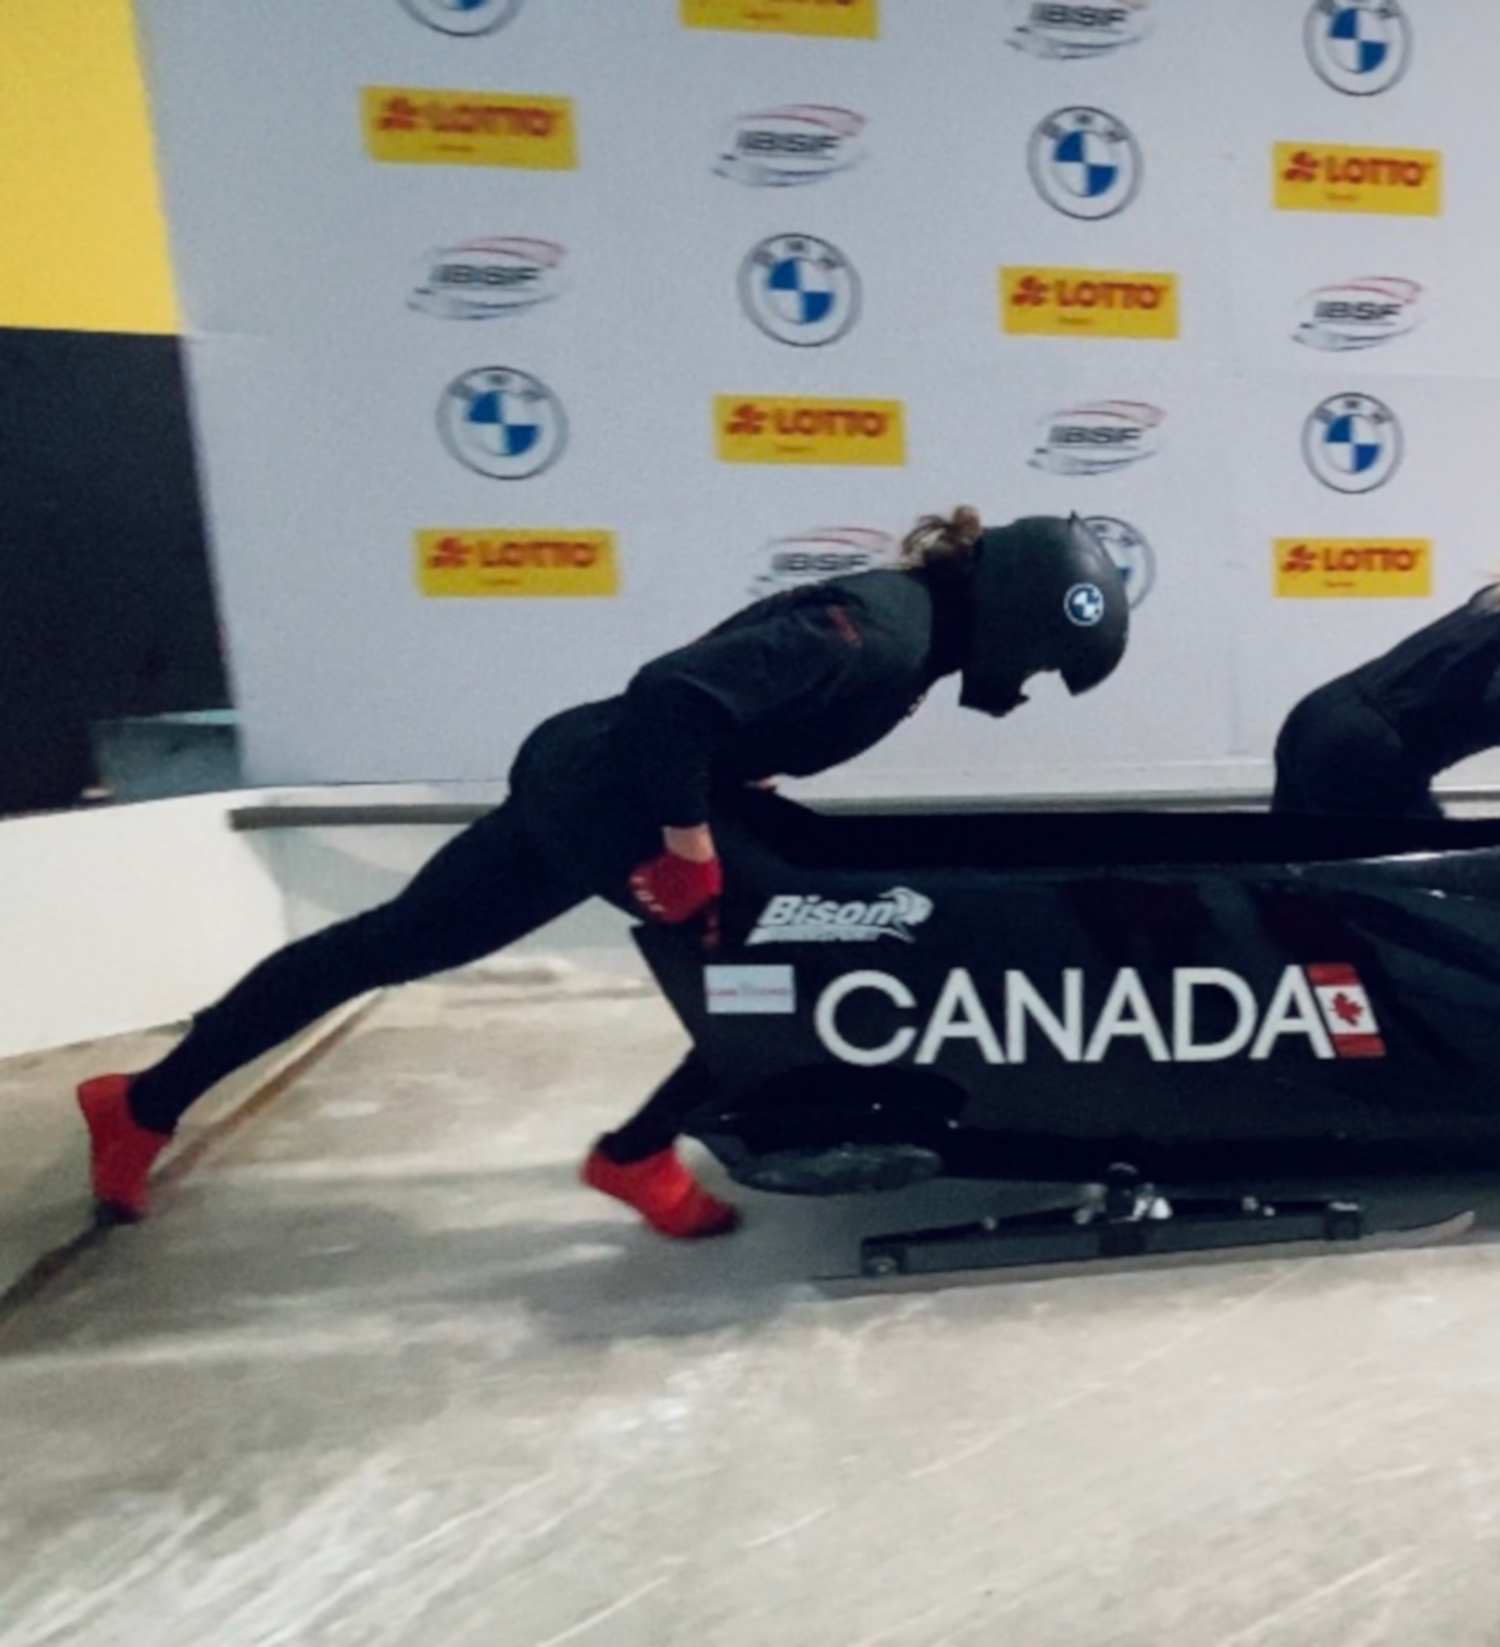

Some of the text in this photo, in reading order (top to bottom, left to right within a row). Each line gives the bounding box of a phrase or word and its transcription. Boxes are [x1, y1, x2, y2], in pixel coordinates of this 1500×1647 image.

[1325, 155, 1424, 188] LOTTO
[1054, 280, 1162, 310] LOTTO
[774, 408, 885, 439] LOTTO
[478, 541, 597, 569] LOTTO
[1322, 545, 1415, 573] LOTTO
[756, 894, 894, 926] Bison
[814, 964, 1335, 1066] CANADA
